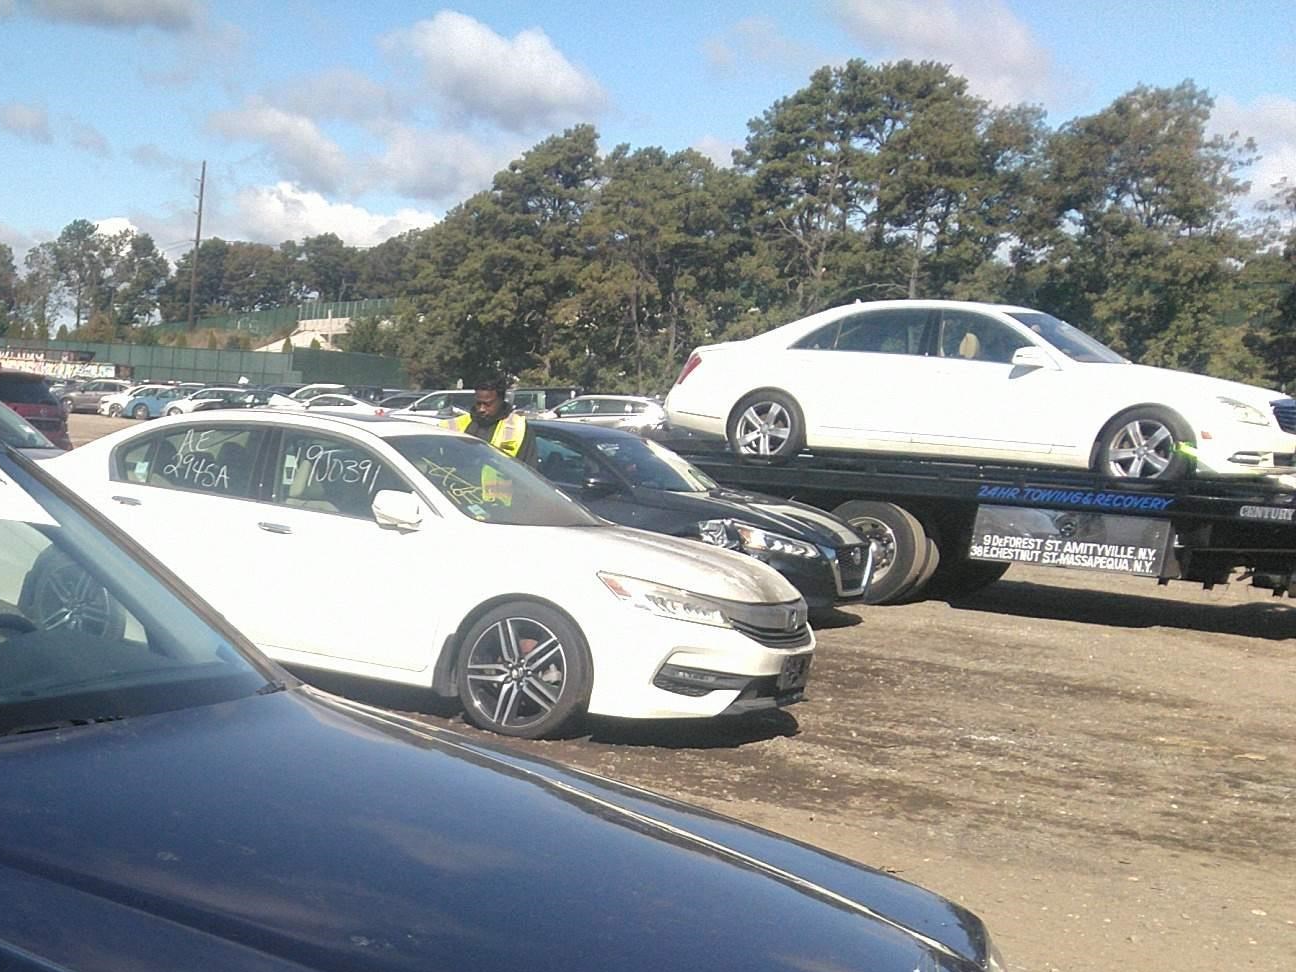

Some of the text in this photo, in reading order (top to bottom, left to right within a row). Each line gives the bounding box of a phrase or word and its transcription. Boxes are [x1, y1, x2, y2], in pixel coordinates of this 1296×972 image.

[176, 428, 216, 453] AE
[163, 453, 231, 489] 2945A
[977, 485, 1020, 498] 24HR
[1239, 505, 1295, 521] CENTURY
[983, 534, 992, 546] 9
[1044, 538, 1062, 552] ST.
